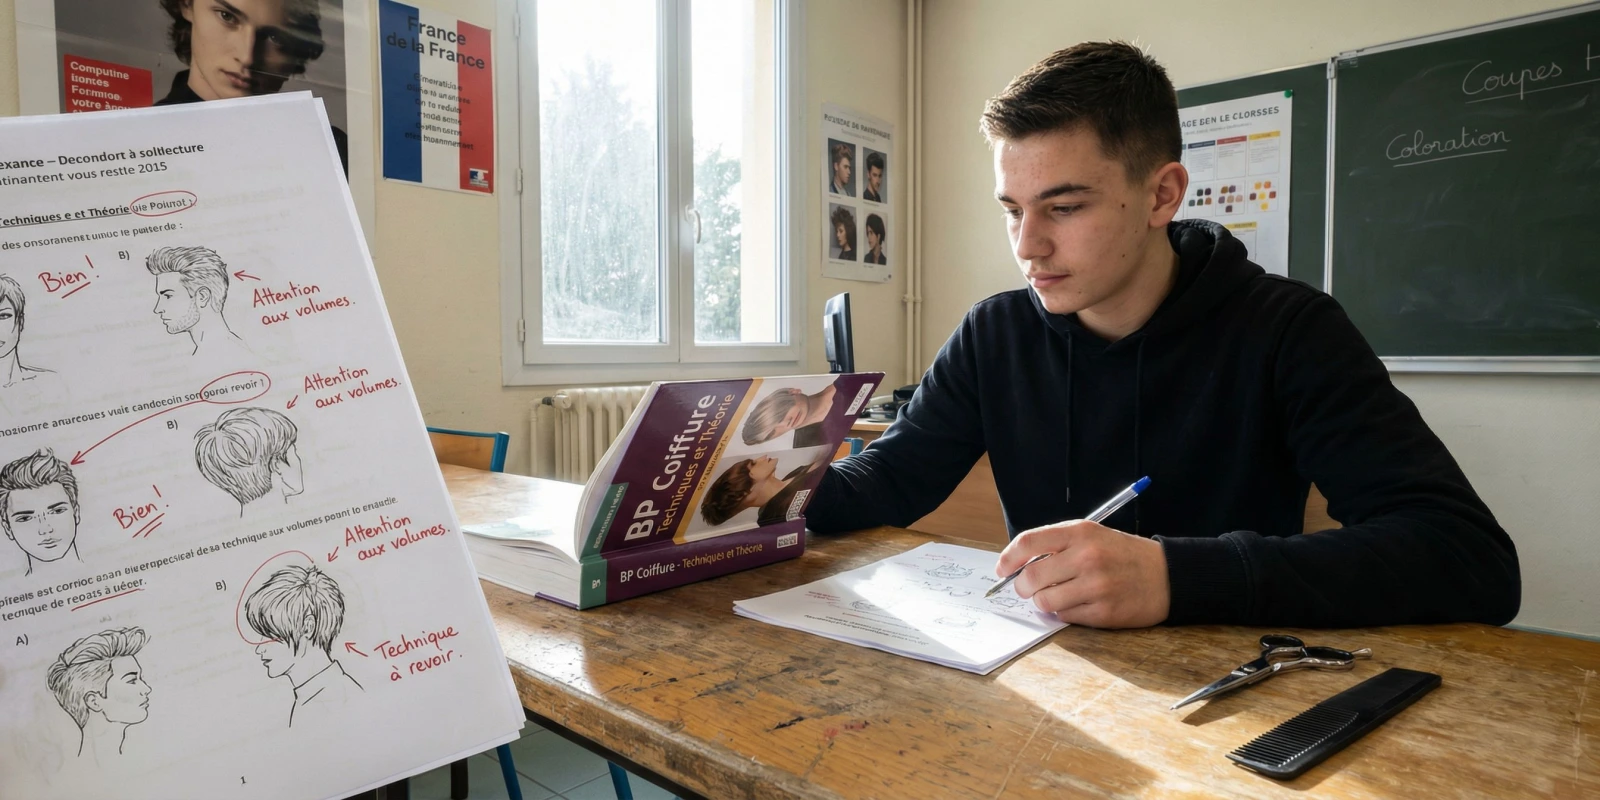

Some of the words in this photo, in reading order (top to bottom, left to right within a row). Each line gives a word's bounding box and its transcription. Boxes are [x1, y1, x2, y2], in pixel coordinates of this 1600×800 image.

[407, 15, 466, 46] France
[387, 32, 407, 49] de
[411, 39, 425, 54] la
[429, 41, 485, 70] France
[1462, 60, 1563, 101] Coupes
[72, 99, 102, 110] votre
[1220, 114, 1230, 123] LE
[1386, 126, 1511, 160] Coloration
[58, 151, 126, 166] Decondort
[129, 150, 137, 159] à
[67, 169, 98, 181] vous
[138, 161, 168, 174] 2015
[74, 210, 86, 219] et
[88, 204, 130, 217] Théorie
[2, 241, 21, 251] des
[118, 250, 130, 261] B)
[251, 280, 321, 308] Attention
[261, 309, 290, 325] aux
[304, 365, 369, 394] Attention
[315, 392, 343, 409] aux
[166, 419, 178, 431] B)
[699, 393, 736, 444] Théorie
[692, 444, 708, 463] et
[623, 498, 660, 542] BP
[652, 393, 718, 492] Coiffure
[655, 461, 699, 535] Techniques
[222, 530, 268, 551] technique
[269, 526, 285, 538] aux
[286, 515, 323, 533] volumes
[344, 514, 412, 547] Attention
[357, 543, 386, 561] aux
[620, 569, 634, 584] BP
[636, 562, 676, 580] Coiffure
[726, 549, 735, 560] et
[215, 579, 227, 591] B)
[50, 595, 65, 609] de
[104, 584, 111, 596] à
[15, 633, 29, 647] A)
[374, 626, 460, 661] Technique
[389, 665, 402, 682] à
[240, 775, 247, 785] 1
